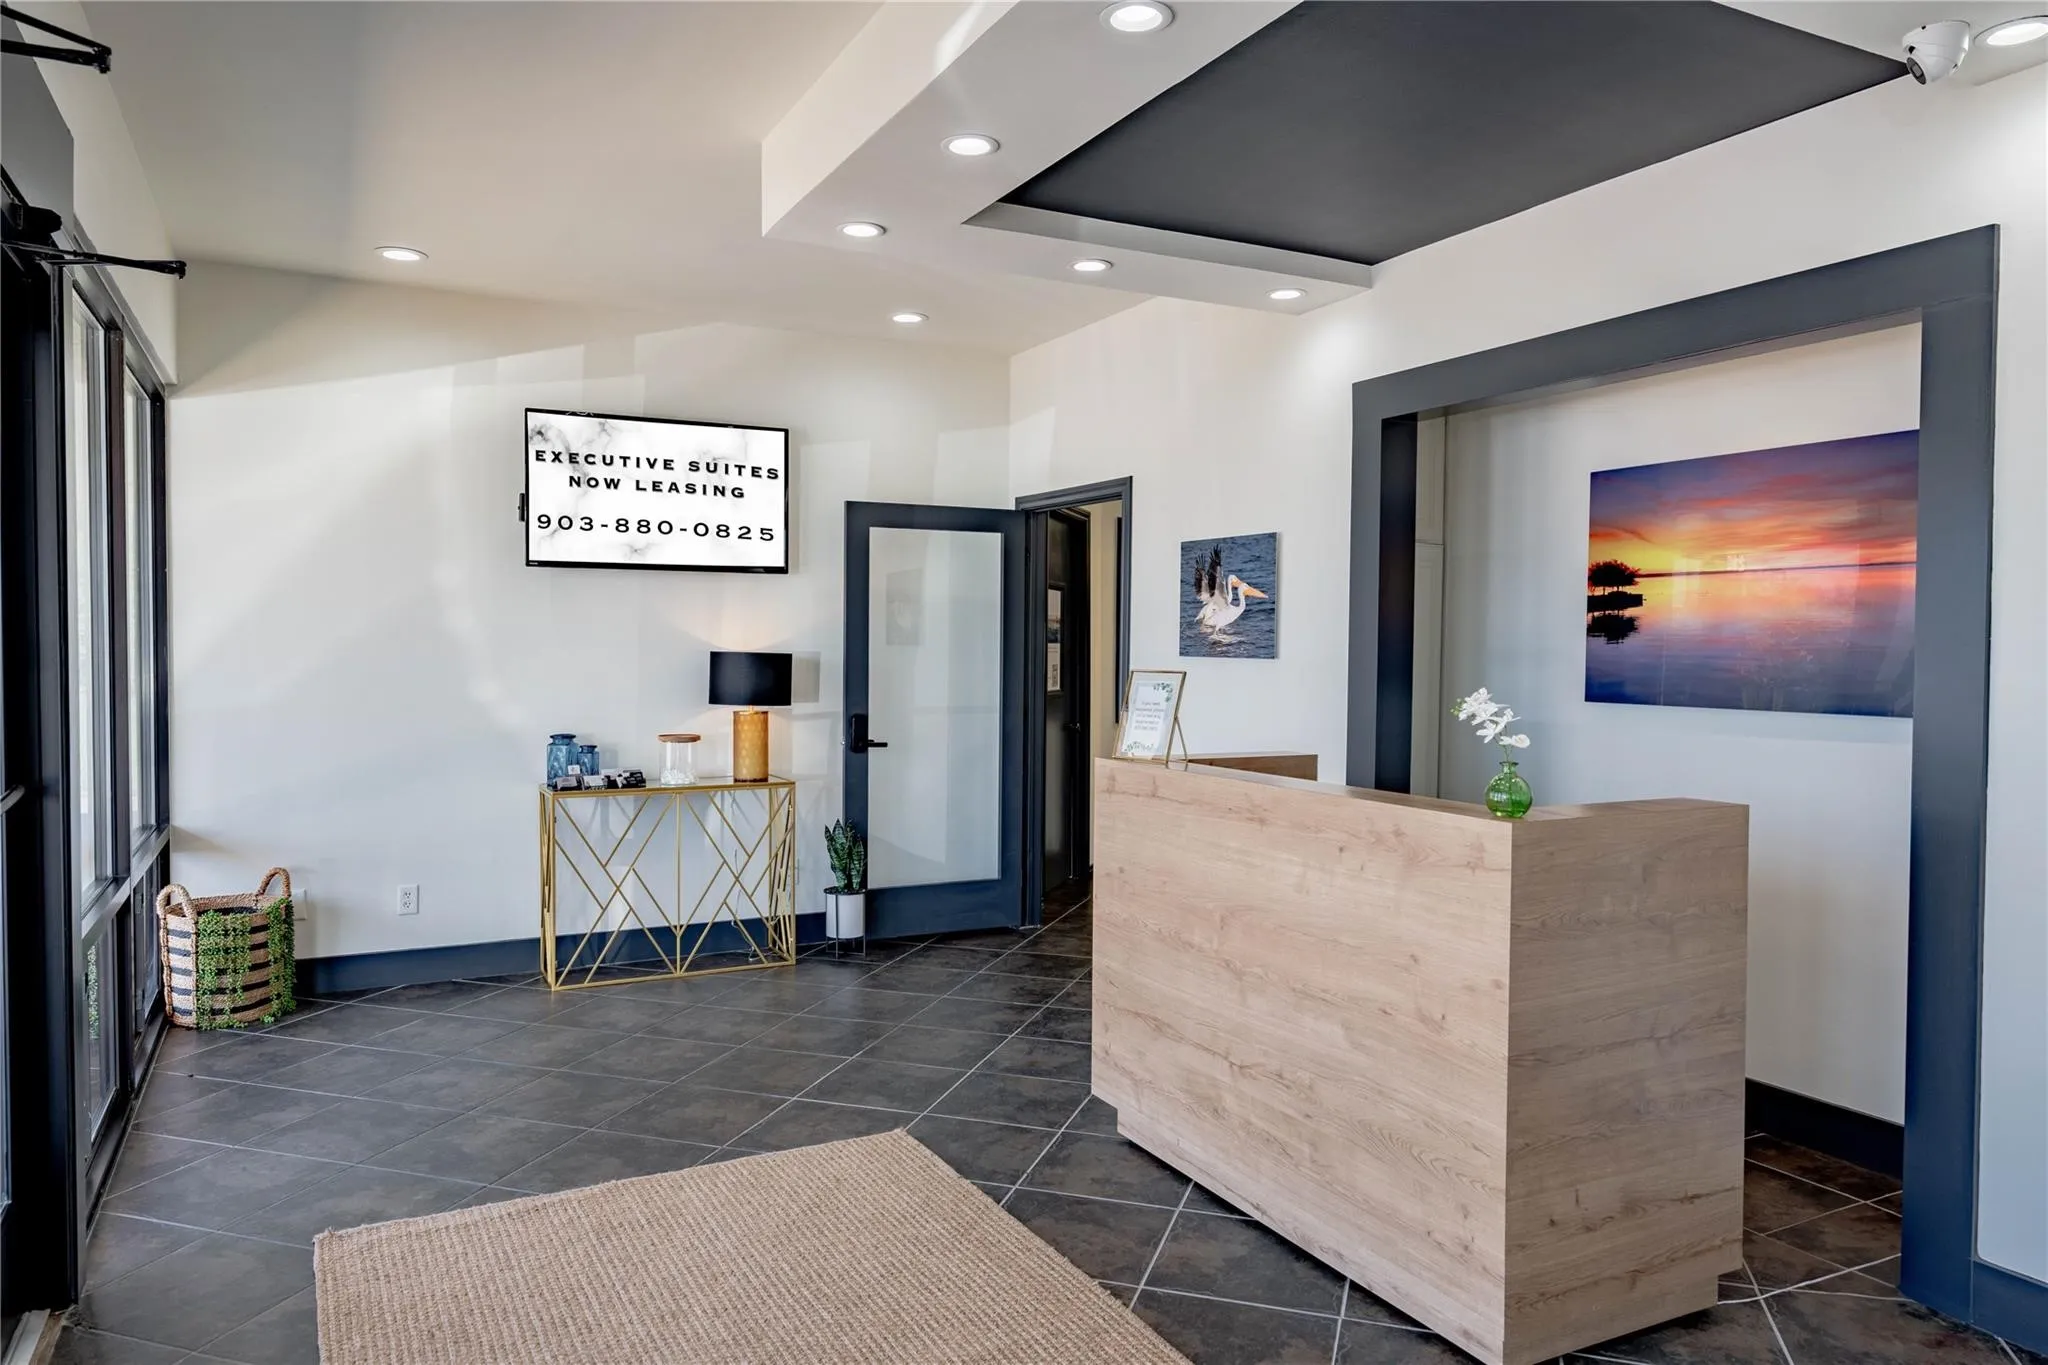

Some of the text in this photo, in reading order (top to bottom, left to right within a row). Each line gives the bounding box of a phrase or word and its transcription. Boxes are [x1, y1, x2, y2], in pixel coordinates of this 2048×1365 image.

[535, 449, 779, 480] EXECUTIVE SUITES
[568, 475, 745, 499] NOW LEASING
[537, 513, 774, 542] 903-880-0825
